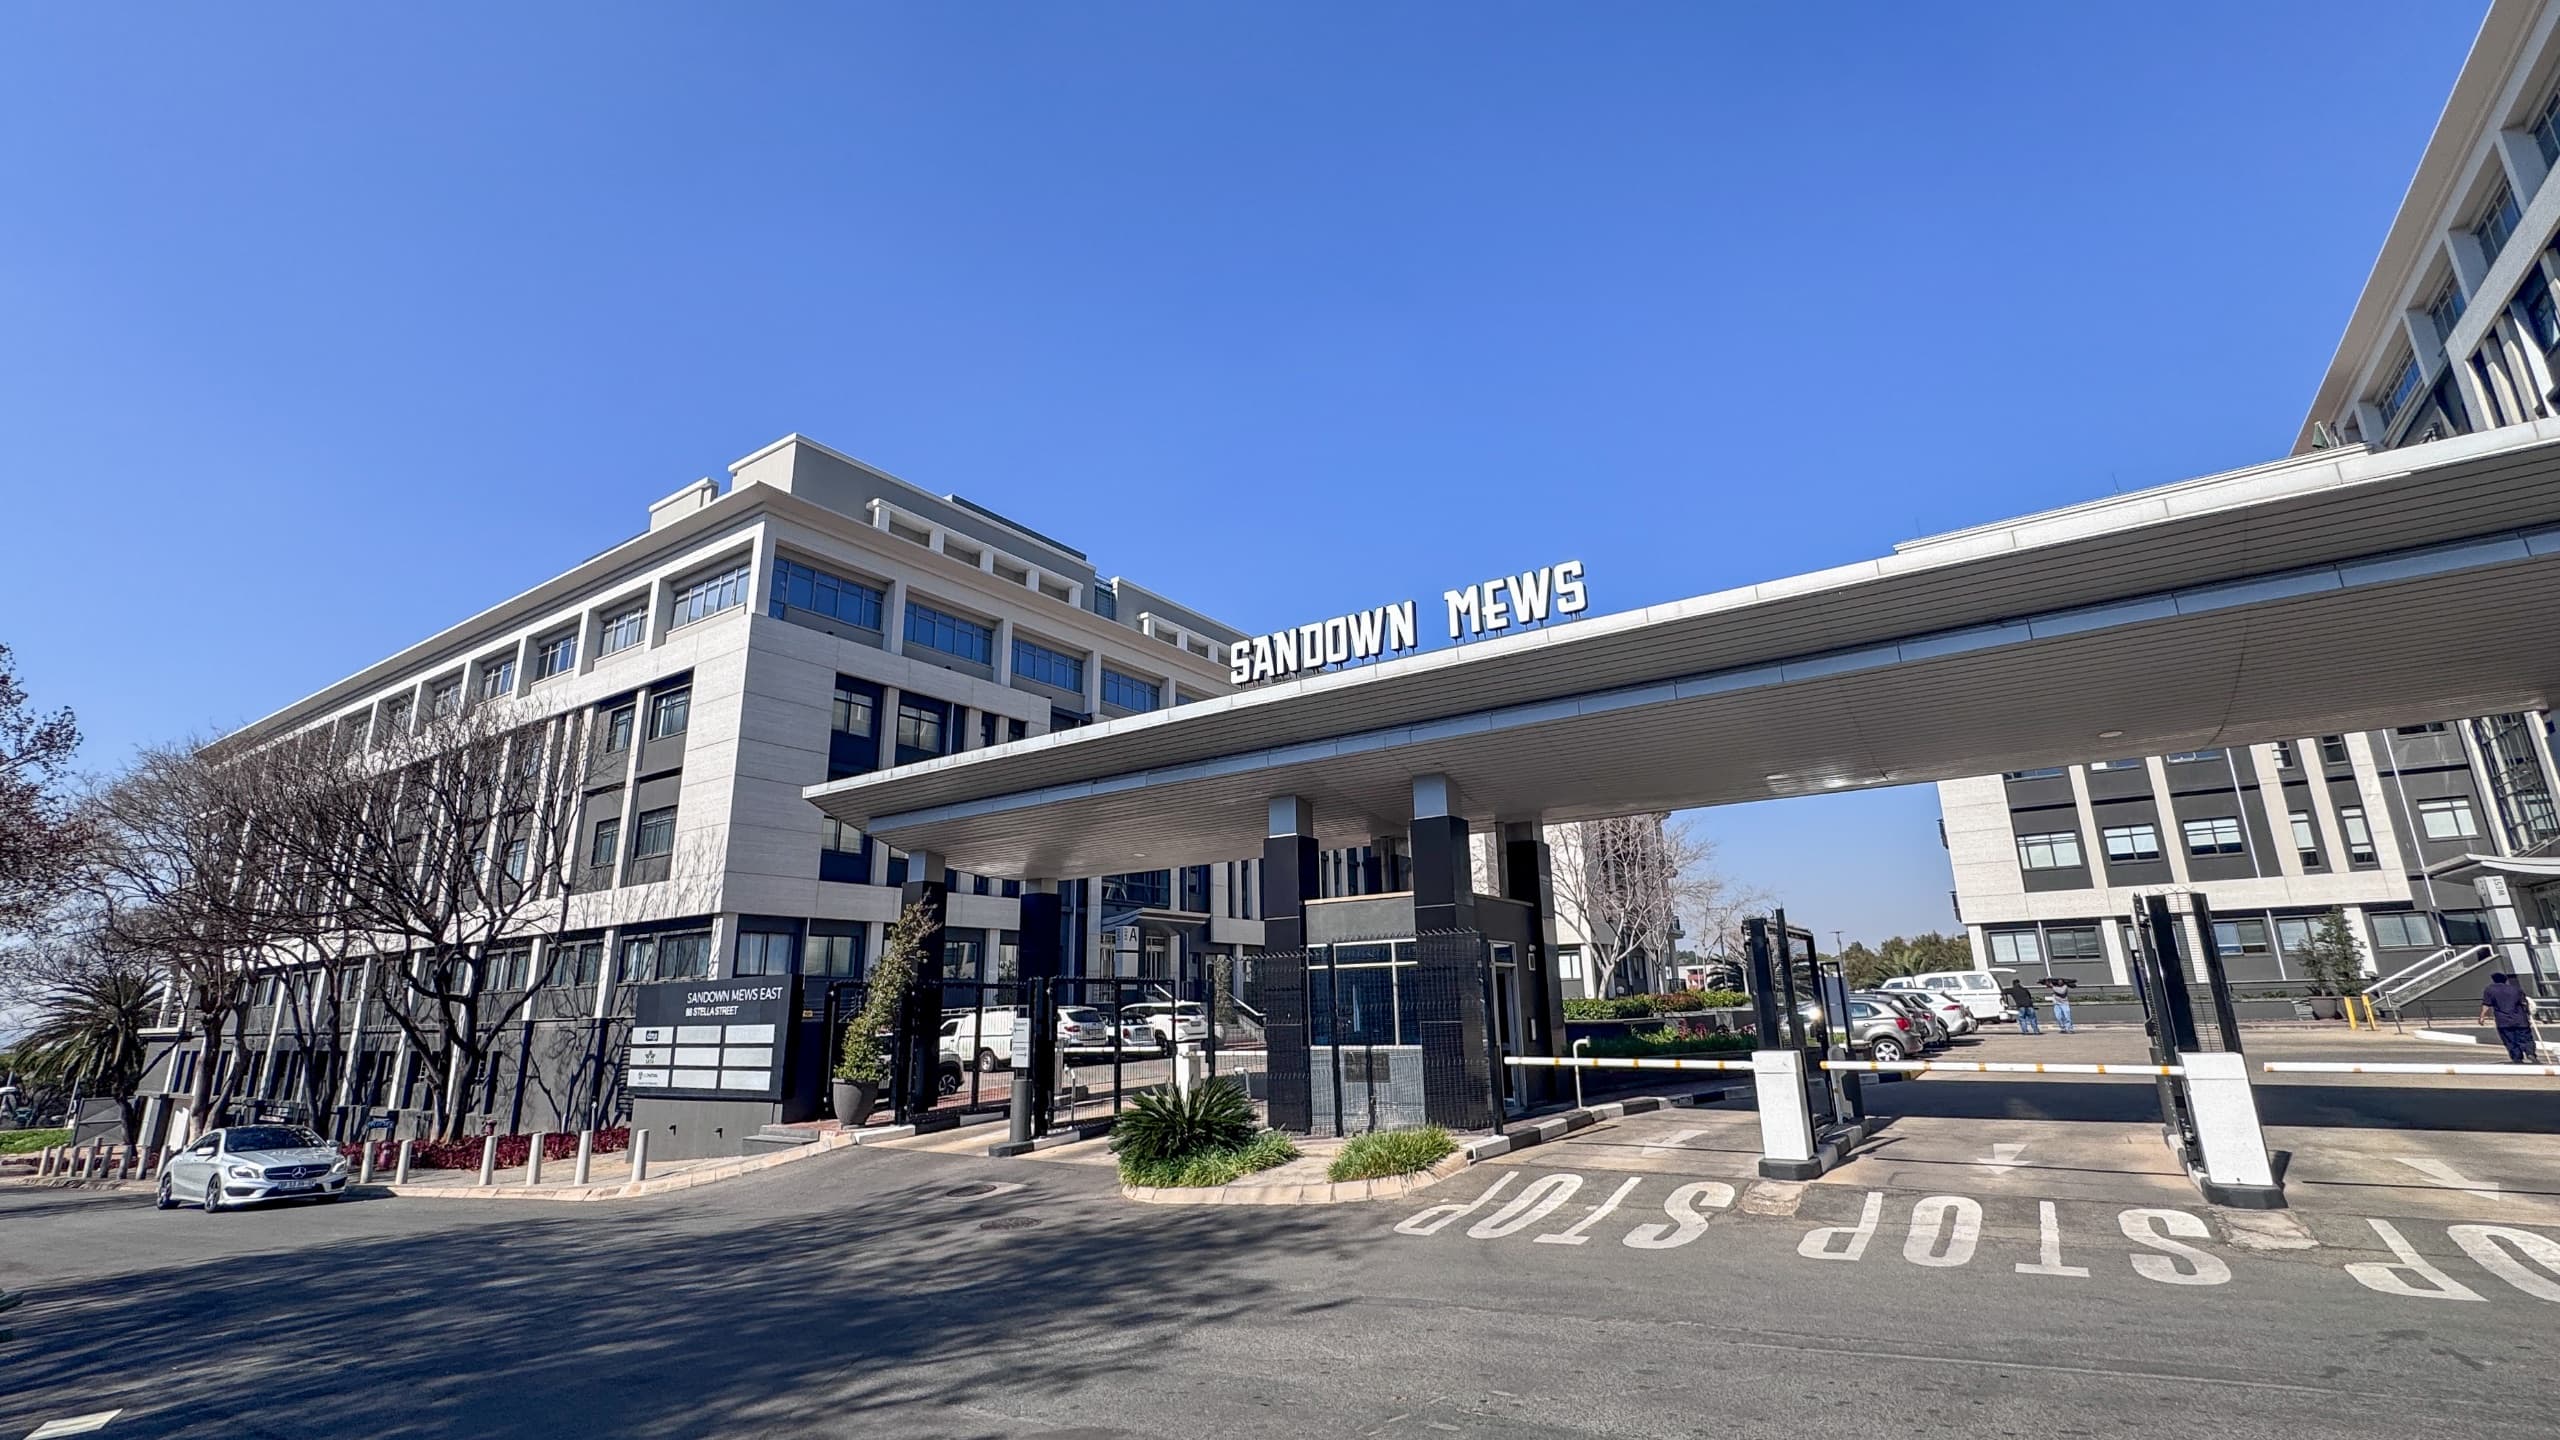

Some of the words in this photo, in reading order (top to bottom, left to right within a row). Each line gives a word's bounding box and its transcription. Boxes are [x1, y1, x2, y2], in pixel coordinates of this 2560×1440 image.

[1230, 600, 1418, 685] SANDOWN
[1444, 560, 1589, 639] MEWS
[1129, 928, 1137, 941] A
[687, 990, 730, 1004] SANDOWN
[731, 988, 759, 1001] MEWS
[760, 986, 783, 1000] EAST
[715, 1005, 739, 1016] STREET
[1393, 1171, 1736, 1249] STOP
[1797, 1191, 2232, 1285] STOP
